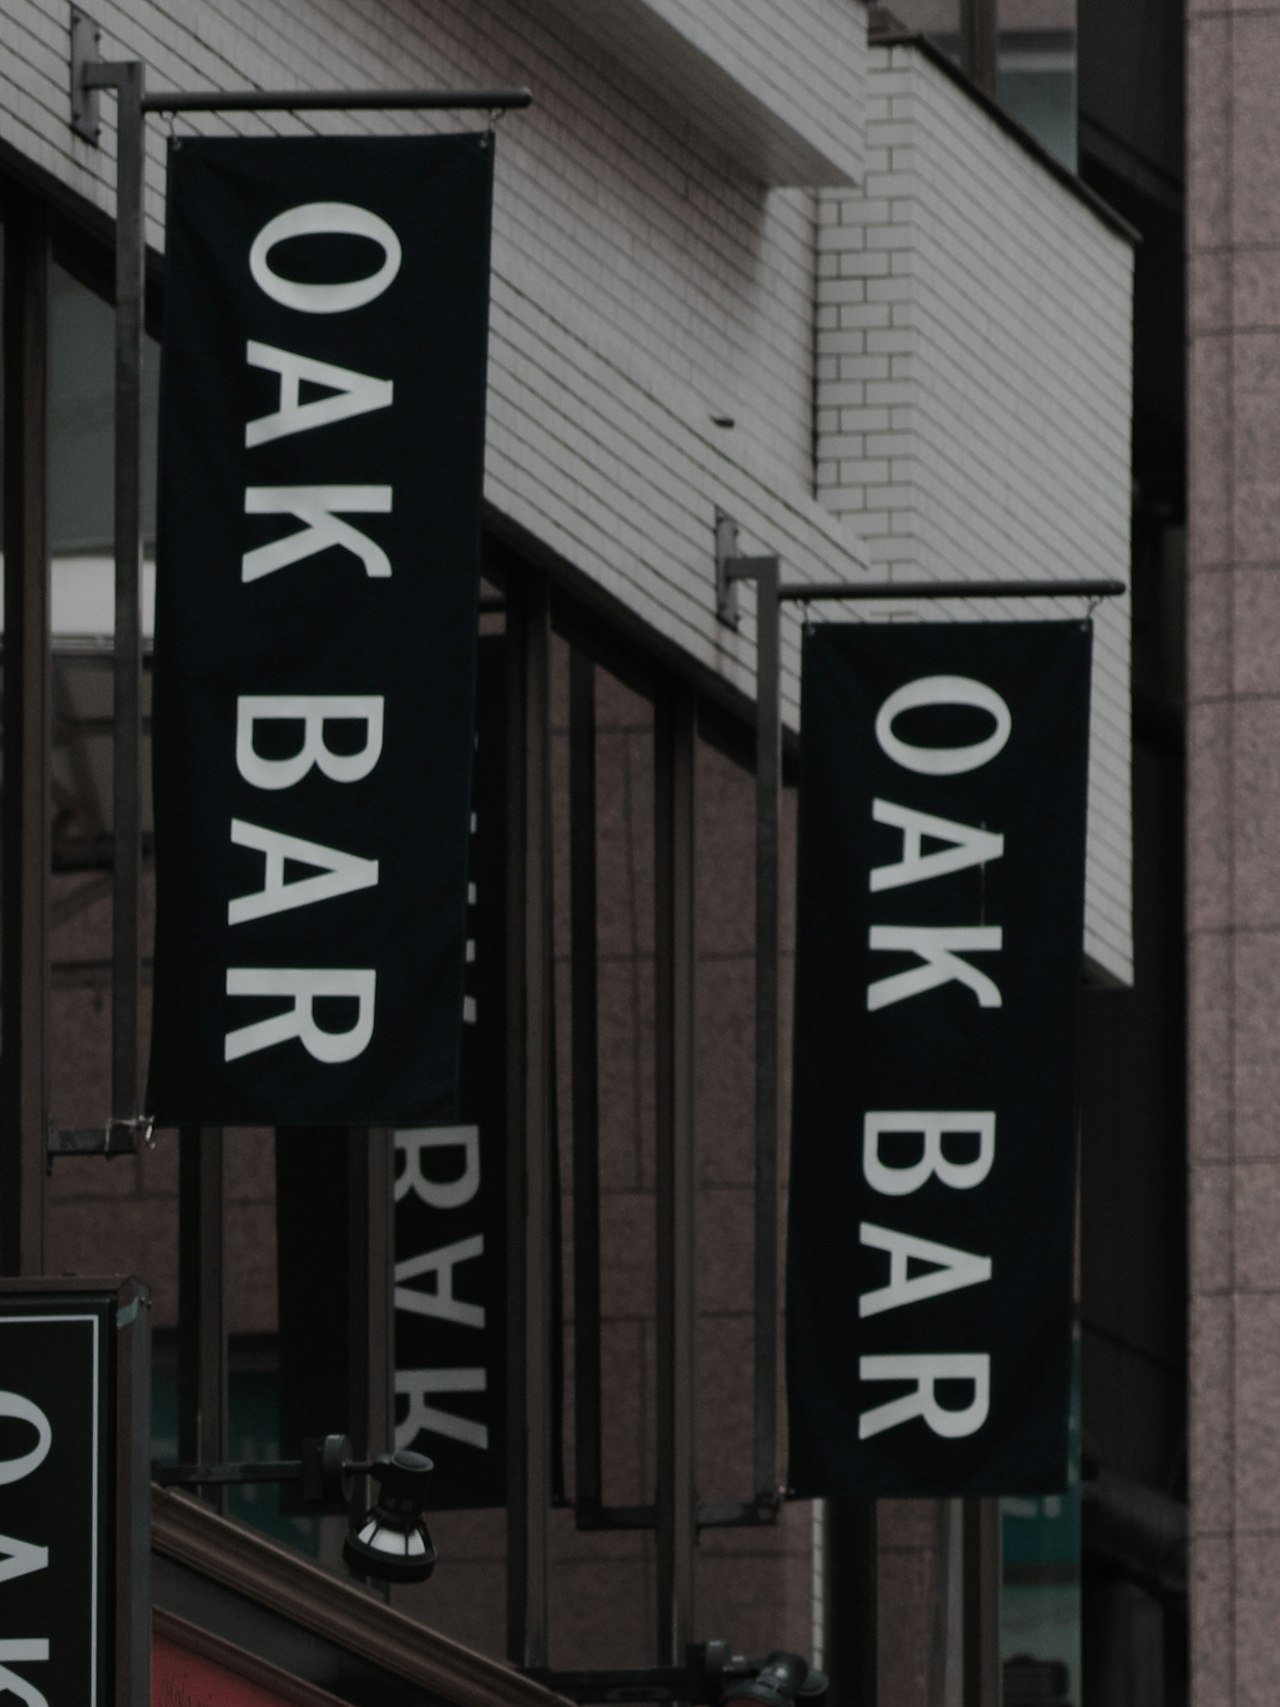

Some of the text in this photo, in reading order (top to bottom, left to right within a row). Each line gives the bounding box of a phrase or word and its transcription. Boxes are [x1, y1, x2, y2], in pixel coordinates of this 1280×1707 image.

[223, 200, 402, 1064] OAK BAR
[857, 675, 1013, 1441] OAK BAR
